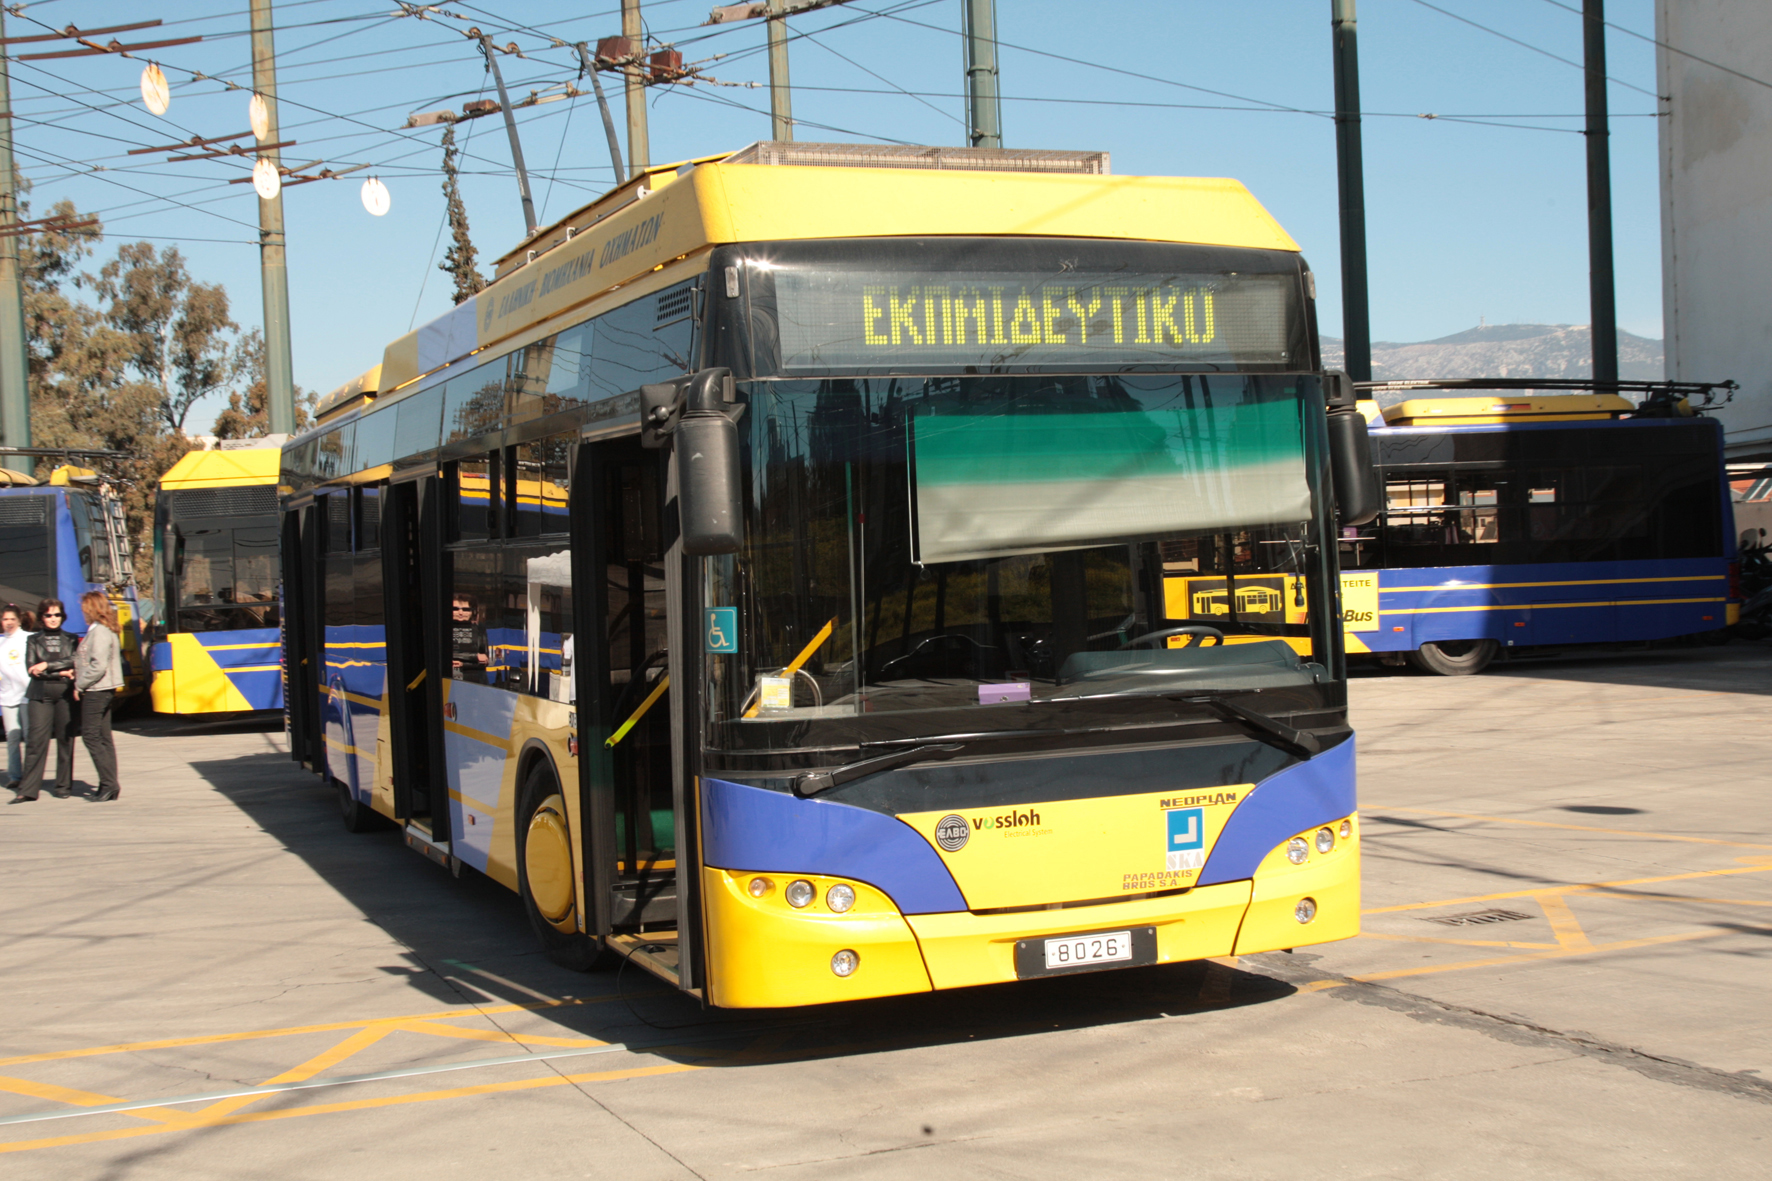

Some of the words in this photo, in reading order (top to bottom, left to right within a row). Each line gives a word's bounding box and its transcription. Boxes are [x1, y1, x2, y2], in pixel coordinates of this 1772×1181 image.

[1343, 609, 1373, 622] Bus
[1160, 792, 1237, 809] NEOPLAN
[972, 809, 1041, 830] vossloh
[1004, 829, 1031, 838] Electrical
[1032, 828, 1053, 837] System
[1123, 869, 1193, 882] PAPADAKIS
[1122, 880, 1156, 891] BROS
[1058, 938, 1118, 963] 8026
